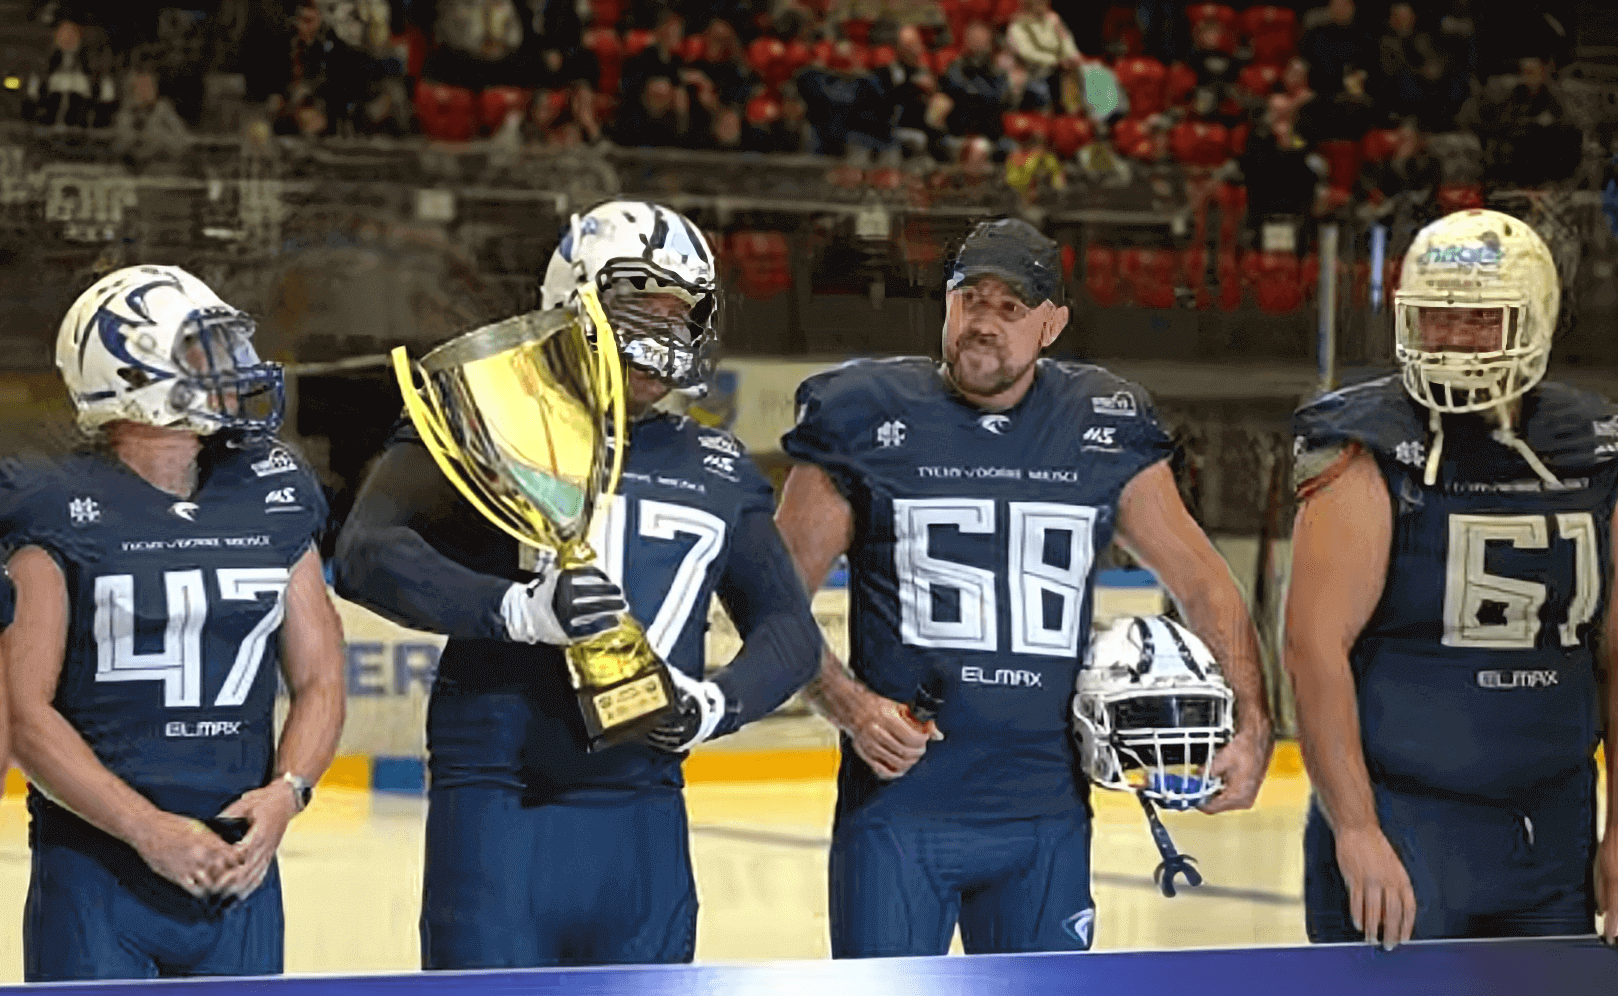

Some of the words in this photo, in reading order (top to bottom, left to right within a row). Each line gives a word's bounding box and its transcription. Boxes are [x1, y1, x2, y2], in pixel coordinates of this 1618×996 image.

[94, 567, 290, 707] 47
[892, 498, 1098, 658] 68
[961, 665, 1042, 687] ELMAX
